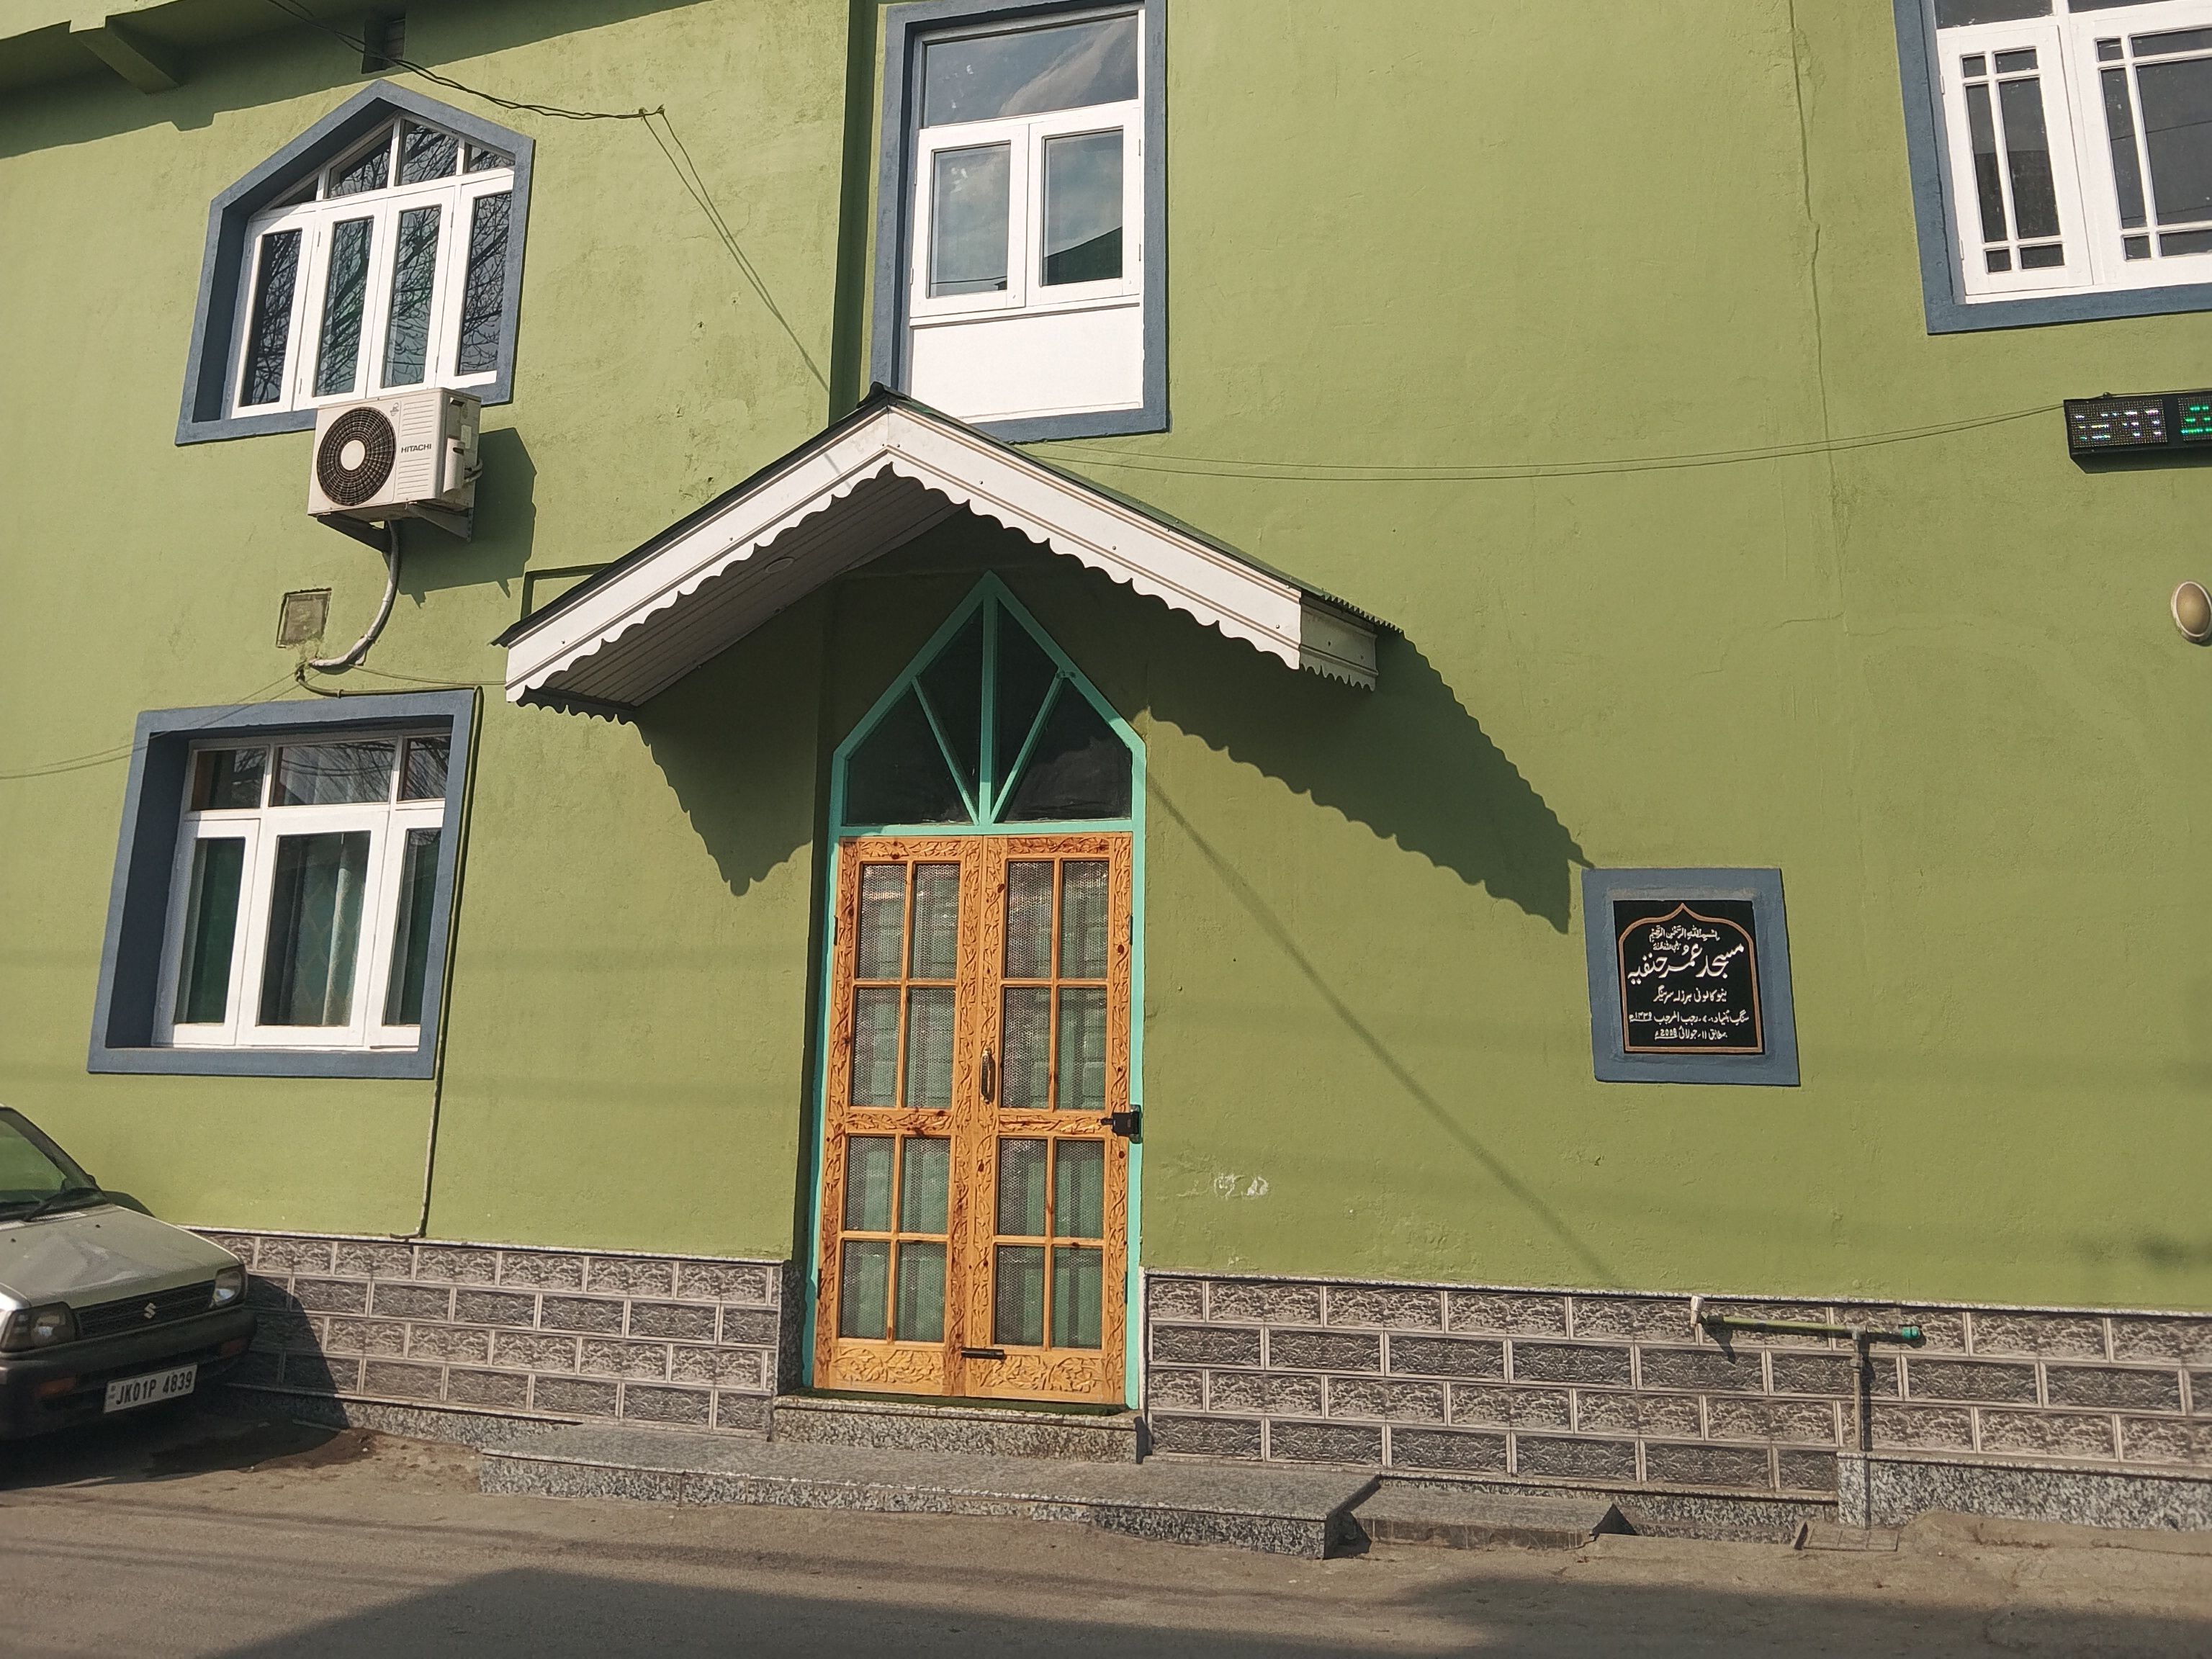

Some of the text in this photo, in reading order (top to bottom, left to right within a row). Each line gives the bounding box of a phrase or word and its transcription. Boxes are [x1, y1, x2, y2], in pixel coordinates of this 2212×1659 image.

[401, 444, 431, 454] HITACHI
[1627, 952, 1668, 985] حنفیہ
[1695, 943, 1745, 979] مسجد
[116, 1379, 157, 1405] JK01P
[163, 1371, 192, 1394] 4839
